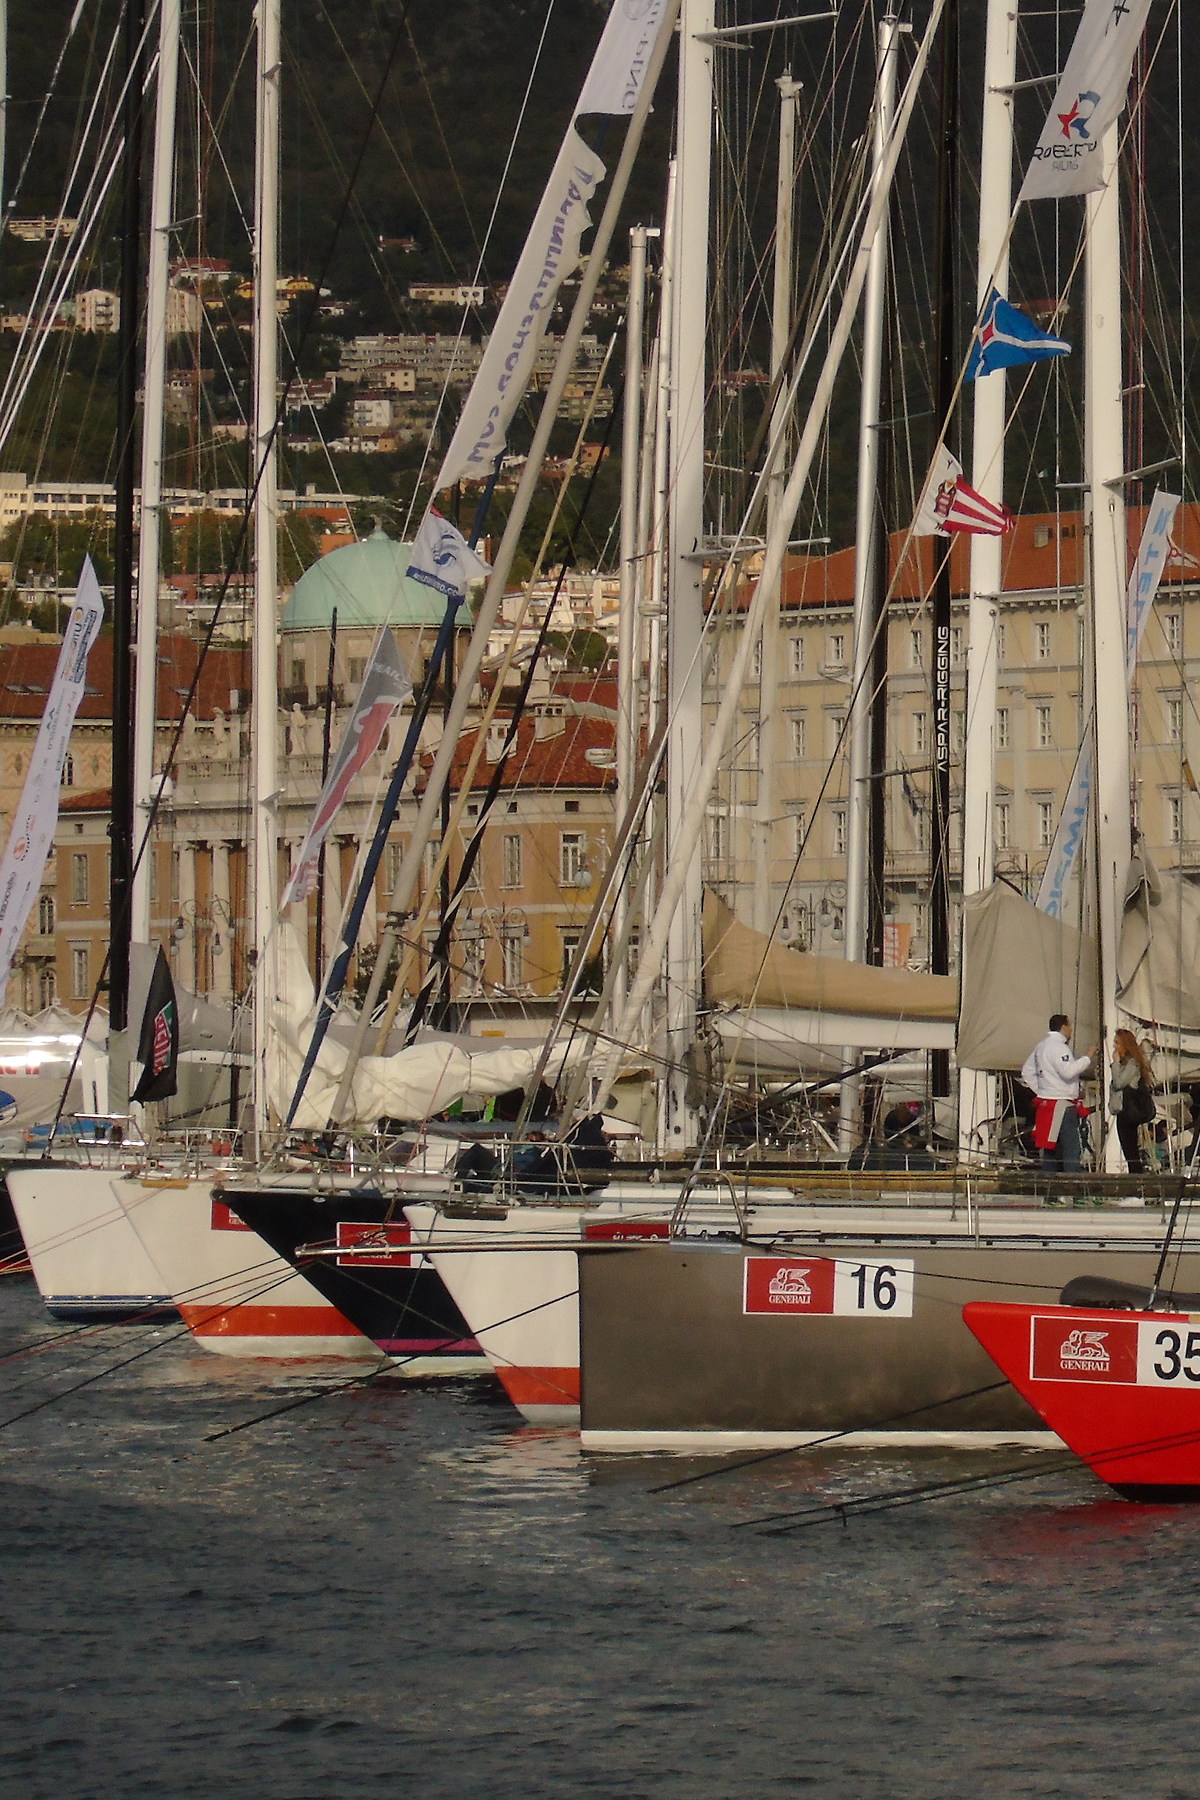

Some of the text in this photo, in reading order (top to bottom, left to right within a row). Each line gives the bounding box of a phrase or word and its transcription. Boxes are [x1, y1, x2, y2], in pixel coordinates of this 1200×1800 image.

[850, 1264, 897, 1311] 16
[768, 1293, 812, 1305] GENERALI
[1059, 1359, 1111, 1373] GENERALI
